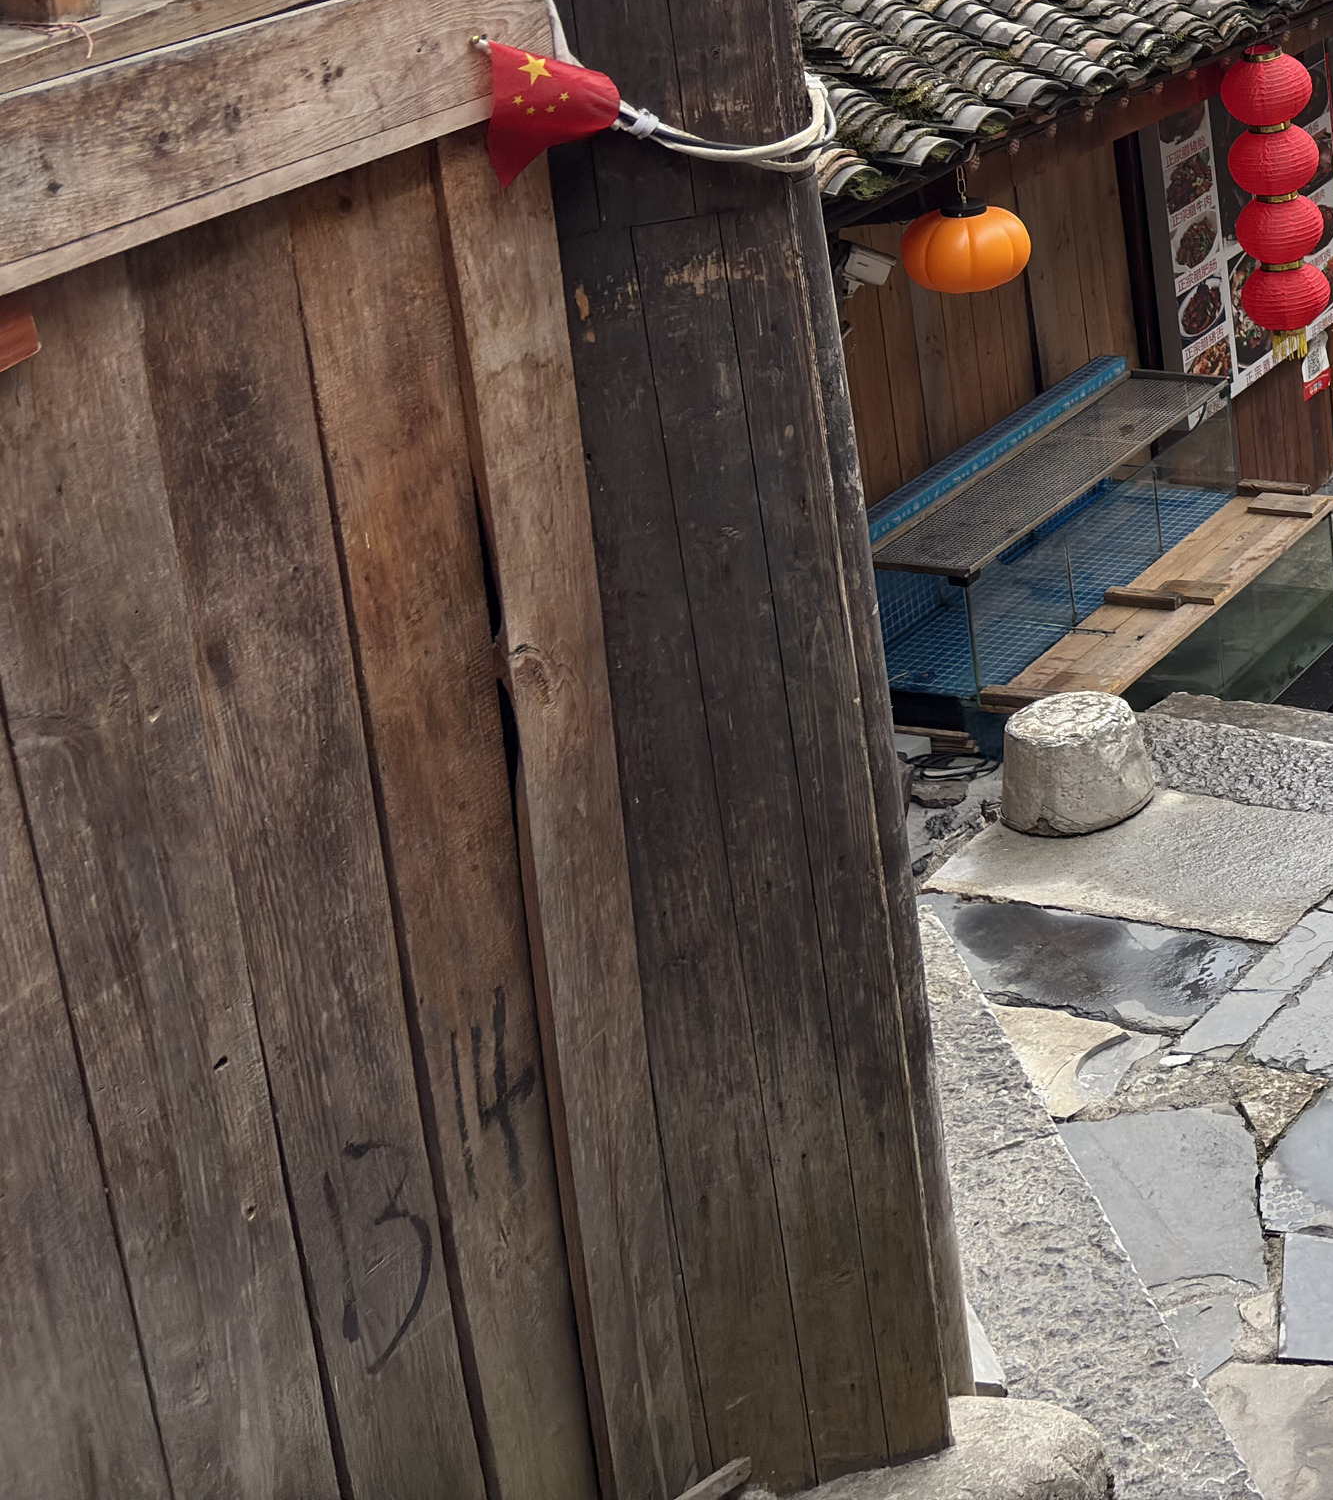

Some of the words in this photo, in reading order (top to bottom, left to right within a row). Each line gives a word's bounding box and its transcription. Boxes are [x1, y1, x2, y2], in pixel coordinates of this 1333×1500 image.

[1171, 195, 1213, 228] 正宗腊牛肉
[1177, 258, 1218, 293] 正宗腊肥肠
[1184, 326, 1224, 362] 正宗腊猪舌
[449, 985, 536, 1201] 14
[324, 1139, 433, 1375] 13
